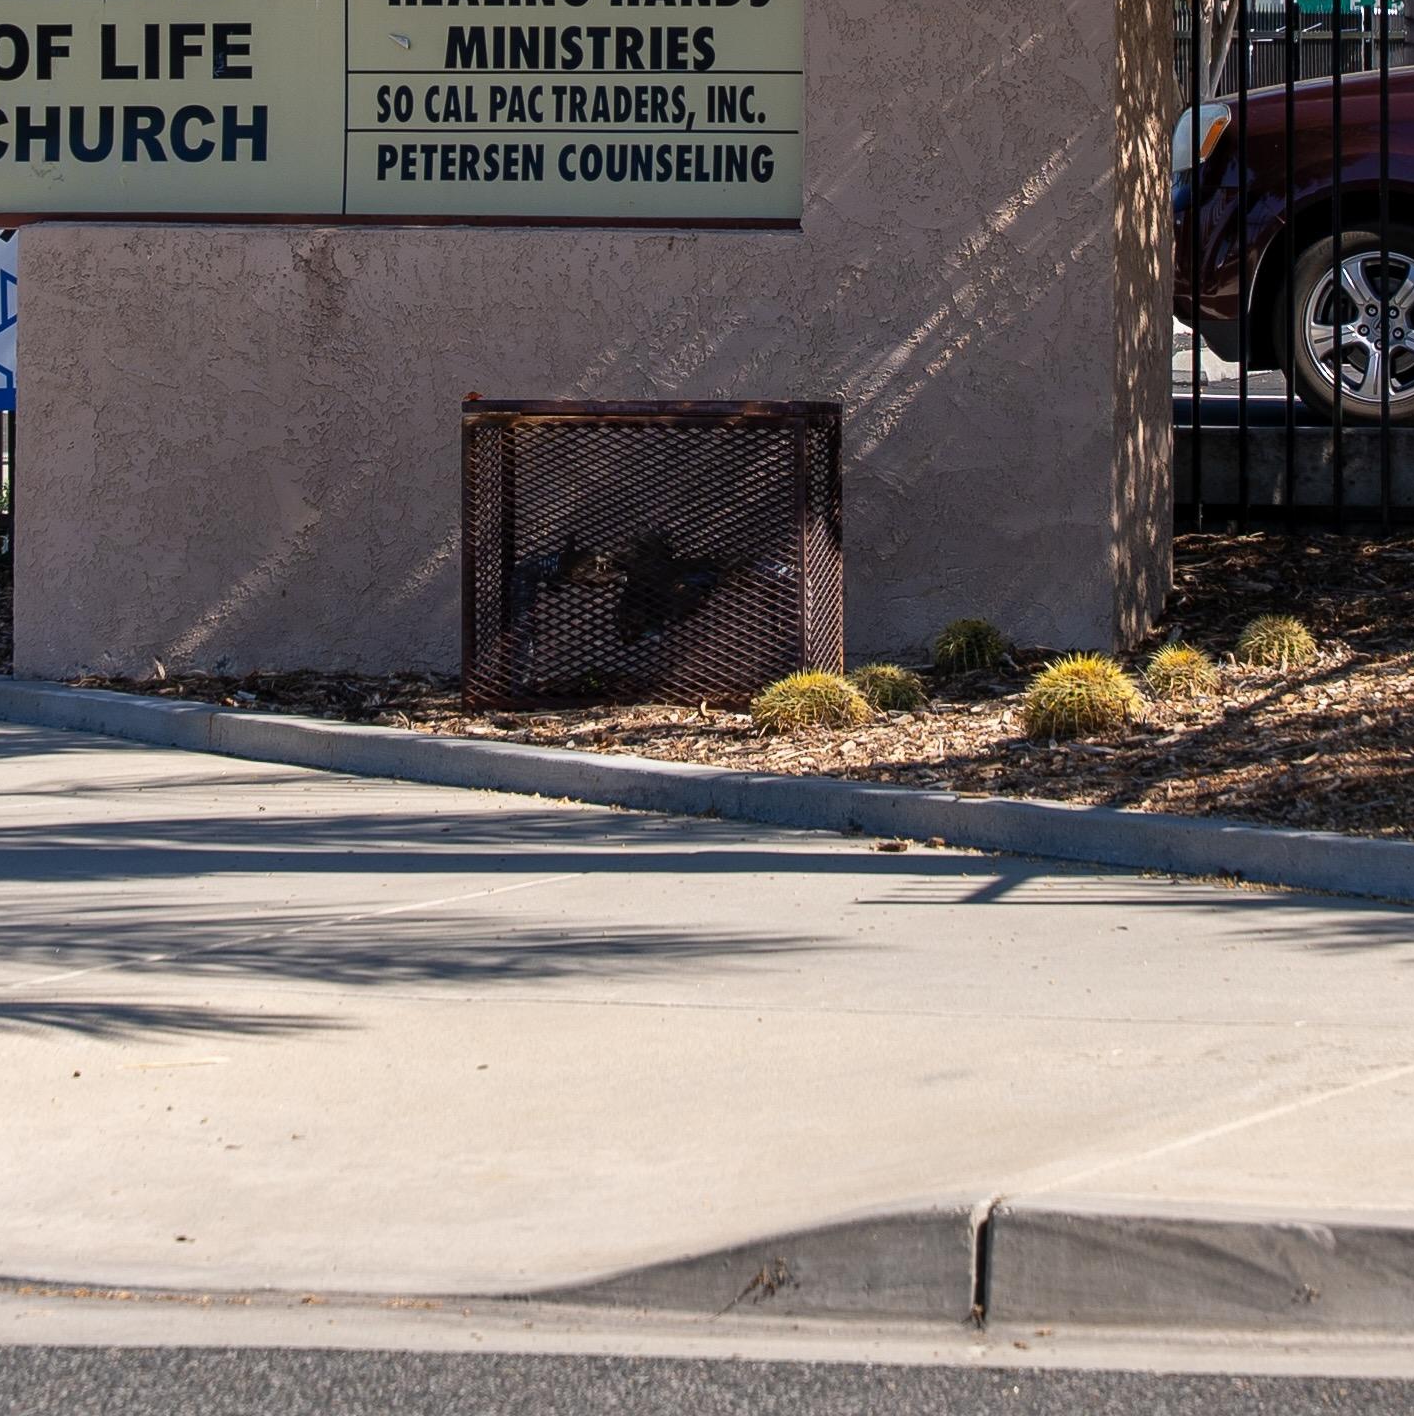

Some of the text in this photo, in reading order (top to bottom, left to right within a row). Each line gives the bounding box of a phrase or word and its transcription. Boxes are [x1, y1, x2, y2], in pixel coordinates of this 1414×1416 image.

[100, 22, 253, 80] LIFE
[444, 25, 716, 71] MINISTRIES
[376, 84, 767, 131] SO CAL PAC TRADERS, INC.
[377, 143, 775, 184] PETERSEN COUNSELING
